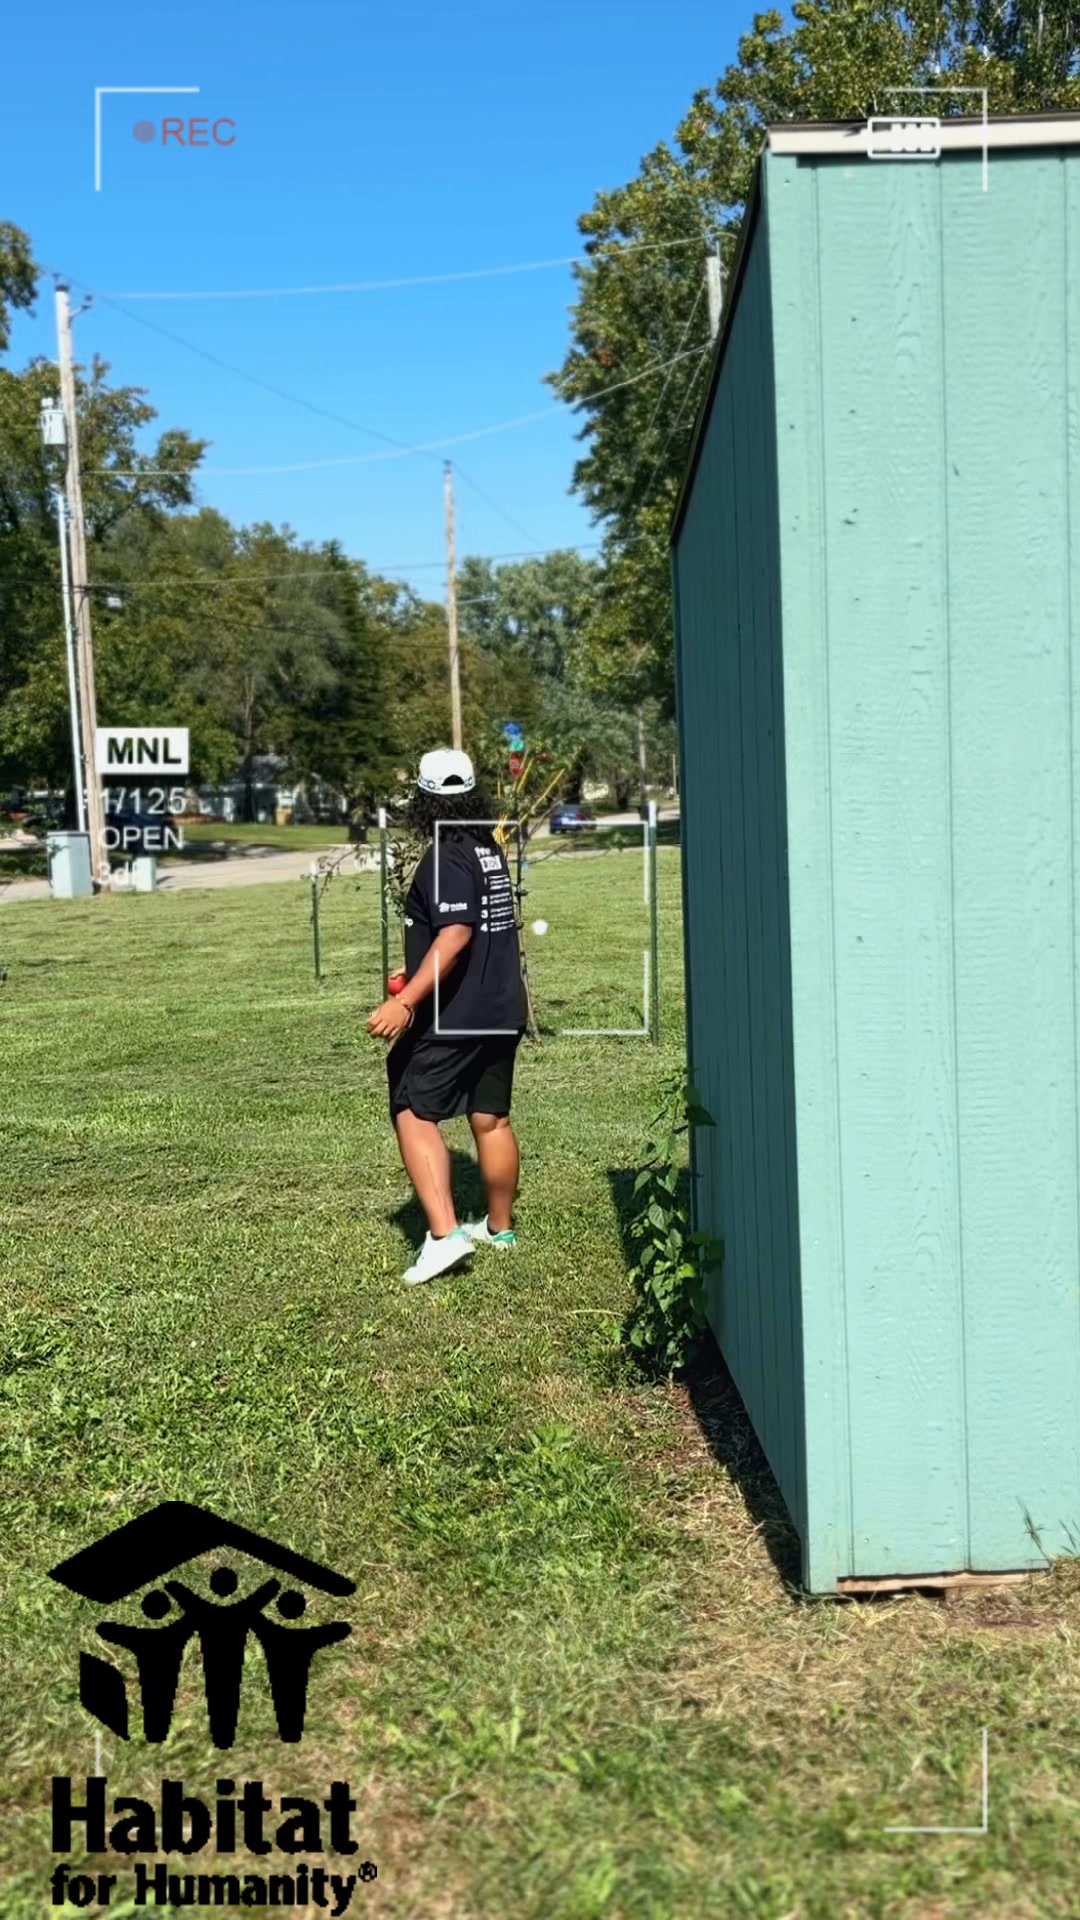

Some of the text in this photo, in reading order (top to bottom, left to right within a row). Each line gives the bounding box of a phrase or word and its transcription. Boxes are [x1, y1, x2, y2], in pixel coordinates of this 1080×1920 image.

[480, 895, 489, 905] 2
[480, 909, 489, 919] 3
[480, 922, 489, 933] 4
